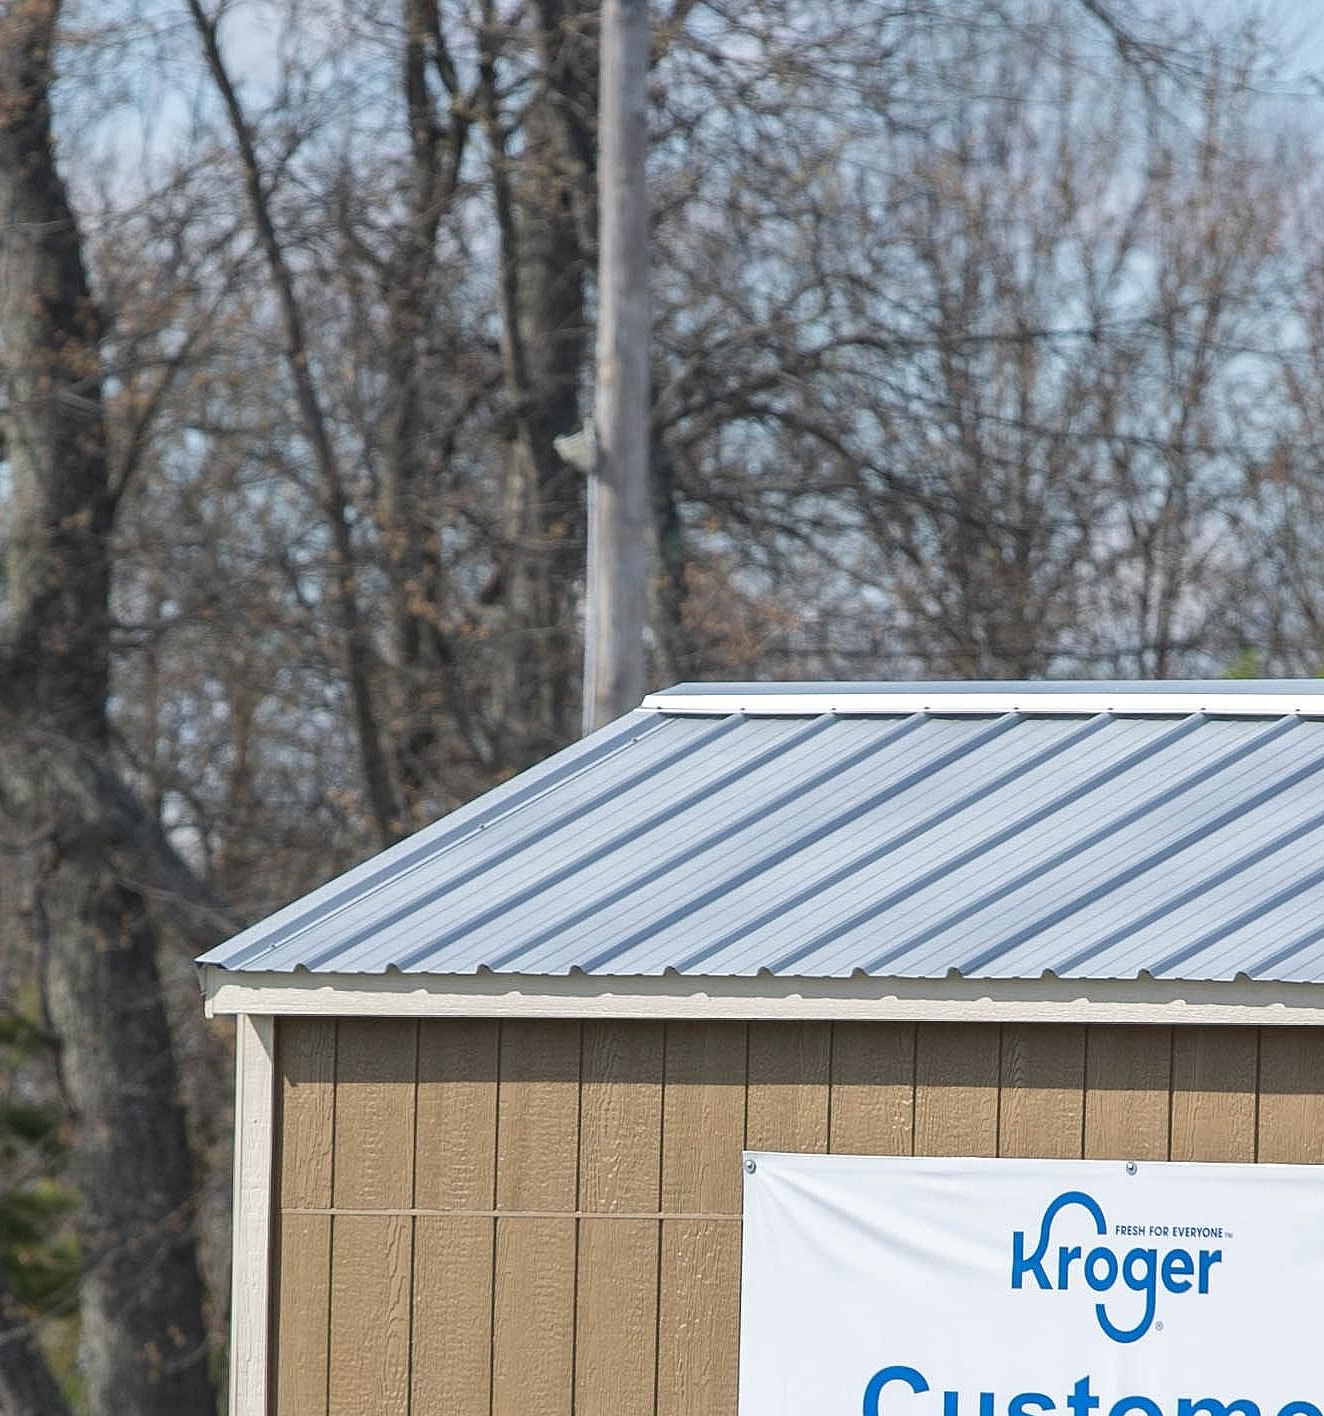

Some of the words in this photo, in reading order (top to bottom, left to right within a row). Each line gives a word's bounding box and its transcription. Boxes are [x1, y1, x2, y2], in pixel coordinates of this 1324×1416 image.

[1011, 1190, 1222, 1344] Kroger
[1115, 1224, 1146, 1237] FRESH
[1149, 1225, 1170, 1237] FOR
[1172, 1226, 1224, 1239] EVERYONE
